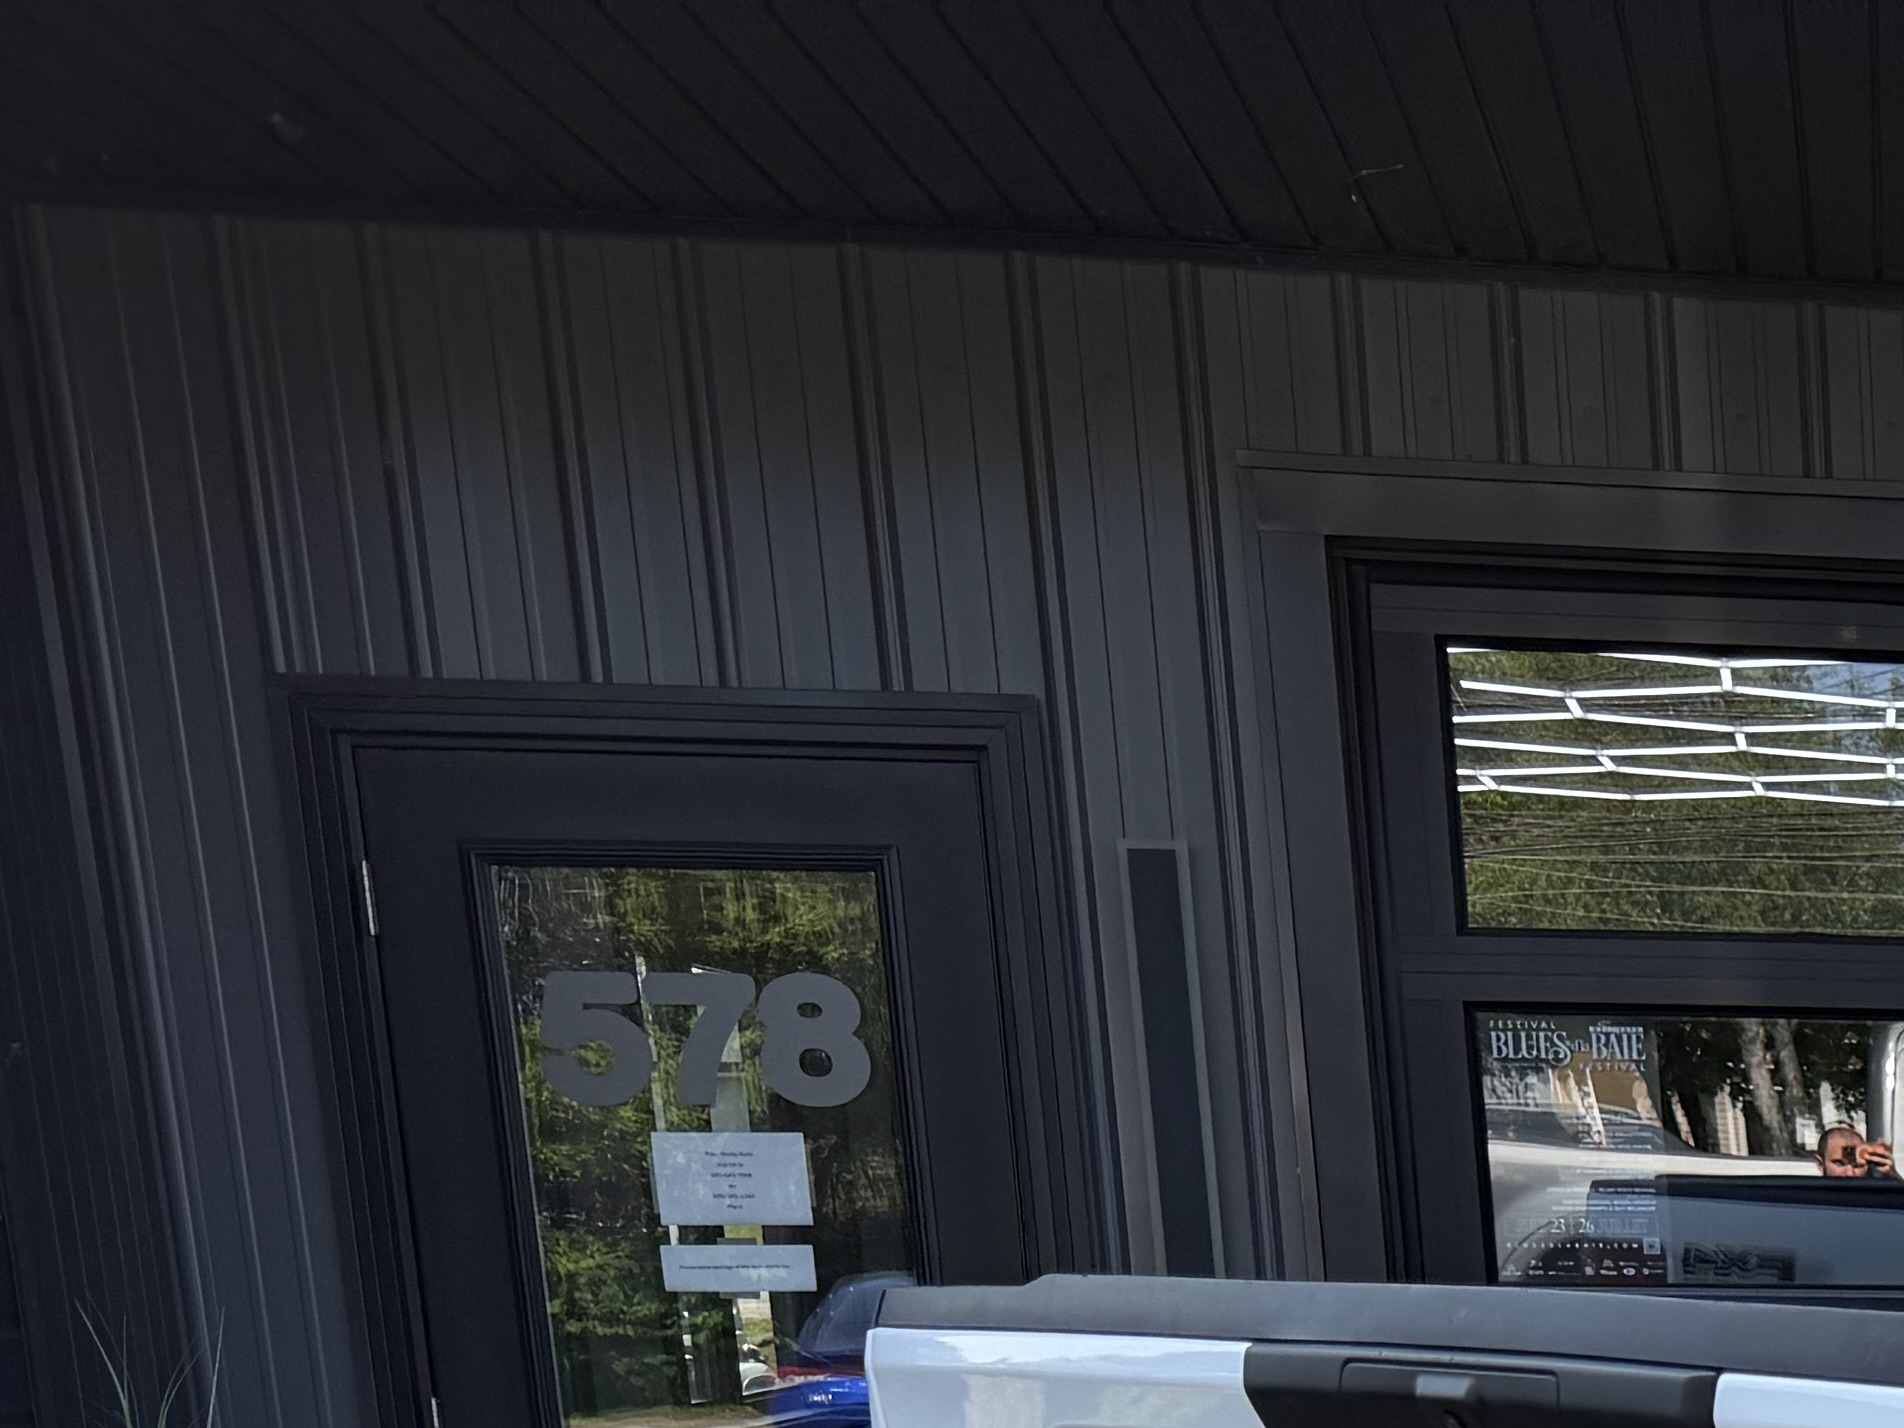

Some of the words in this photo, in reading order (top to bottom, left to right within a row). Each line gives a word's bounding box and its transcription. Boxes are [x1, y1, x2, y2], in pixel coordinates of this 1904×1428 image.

[1490, 1020, 1556, 1029] FESTIVAL
[540, 970, 872, 1108] 578
[1490, 1031, 1572, 1066] BLUES
[1590, 1031, 1647, 1060] BAIE
[1550, 1218, 1566, 1233] 23
[1578, 1218, 1595, 1233] 26
